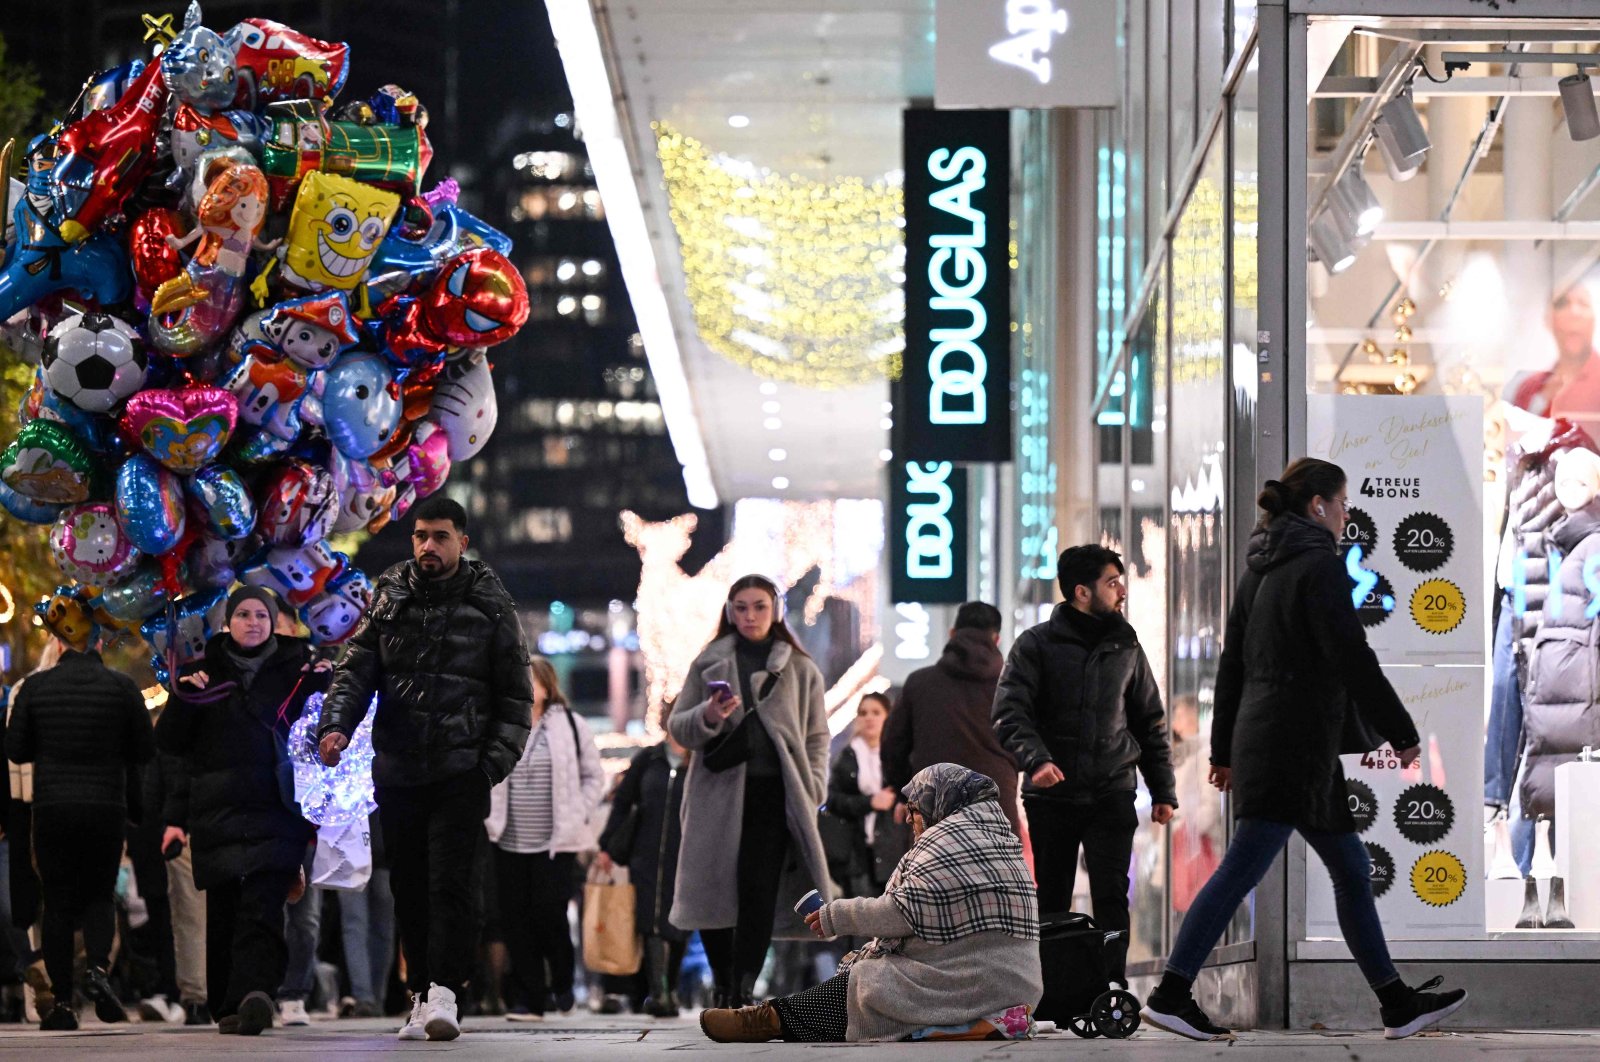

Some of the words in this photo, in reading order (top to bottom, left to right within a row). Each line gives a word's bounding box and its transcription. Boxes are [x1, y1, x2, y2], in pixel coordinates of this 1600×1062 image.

[927, 146, 987, 425] DOUGLAS
[1360, 477, 1375, 498] 4
[1376, 478, 1420, 486] TREUE
[1376, 488, 1420, 498] BONS
[1341, 522, 1370, 540] 0%
[1348, 795, 1370, 812] 0%
